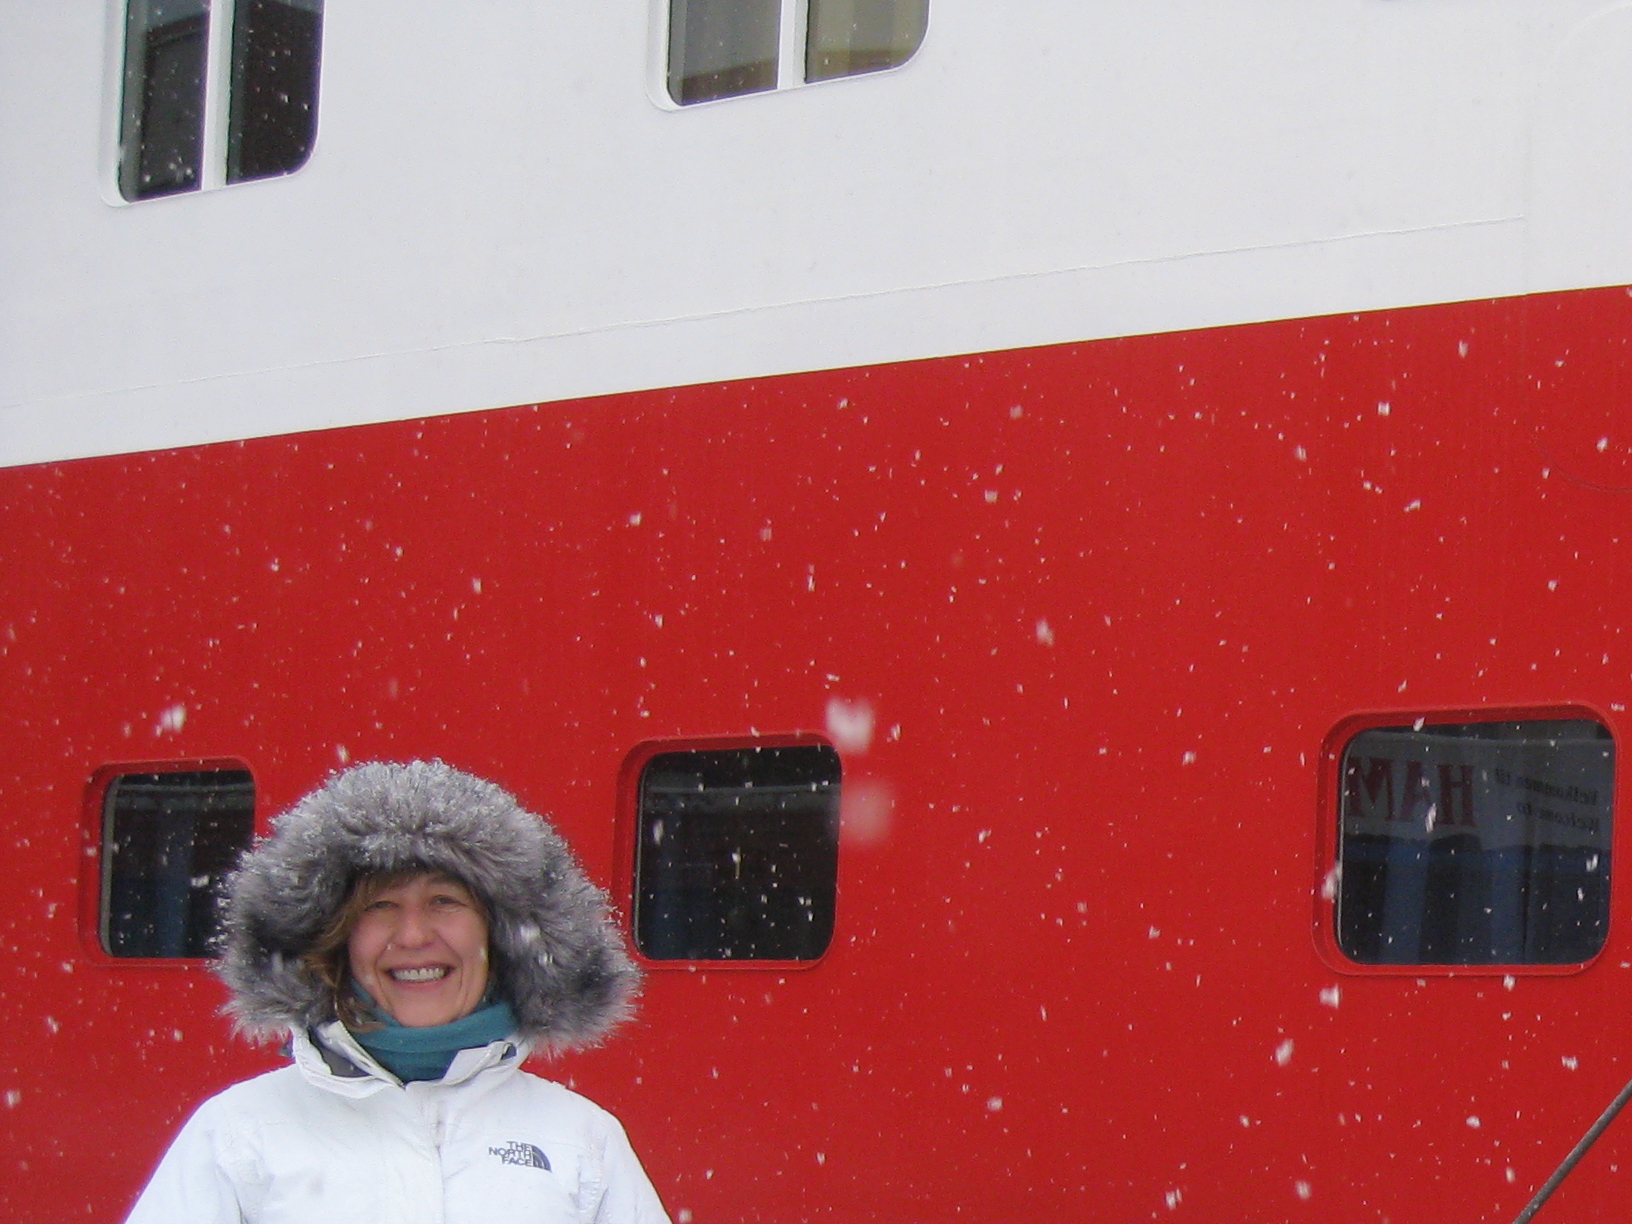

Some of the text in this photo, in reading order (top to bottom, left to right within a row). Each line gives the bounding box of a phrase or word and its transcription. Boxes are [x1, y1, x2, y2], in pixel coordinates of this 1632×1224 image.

[506, 1140, 532, 1152] THE
[488, 1146, 532, 1161] NORTH
[501, 1155, 533, 1167] FACE
